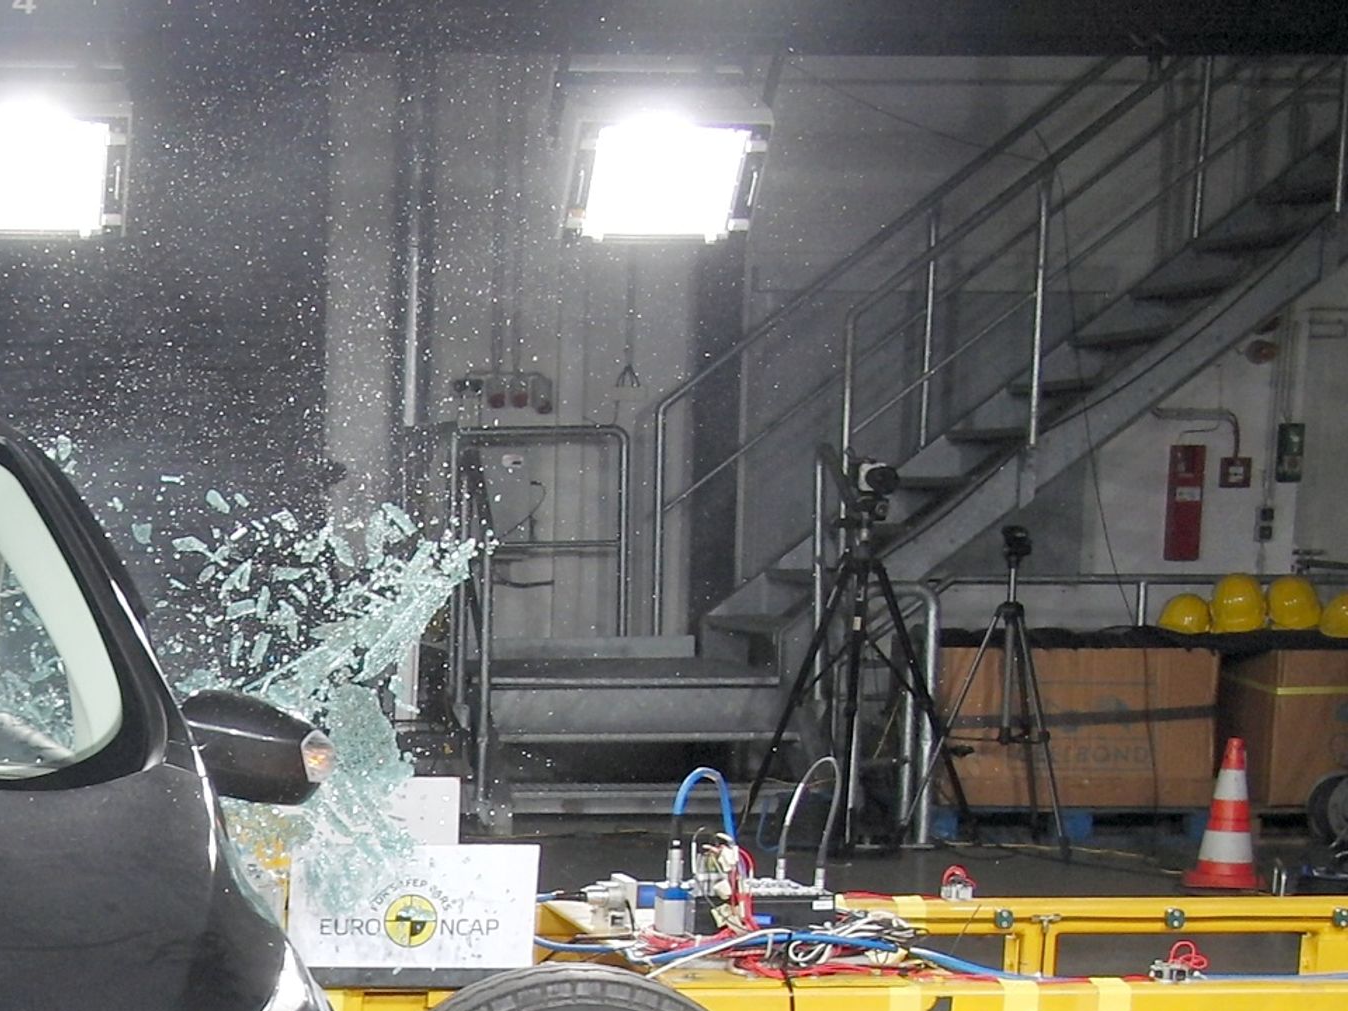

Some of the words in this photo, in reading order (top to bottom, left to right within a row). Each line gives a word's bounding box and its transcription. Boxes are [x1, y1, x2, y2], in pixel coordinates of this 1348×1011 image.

[388, 878, 428, 892] SFER
[319, 918, 381, 936] EURO
[439, 918, 500, 936] NCAP
